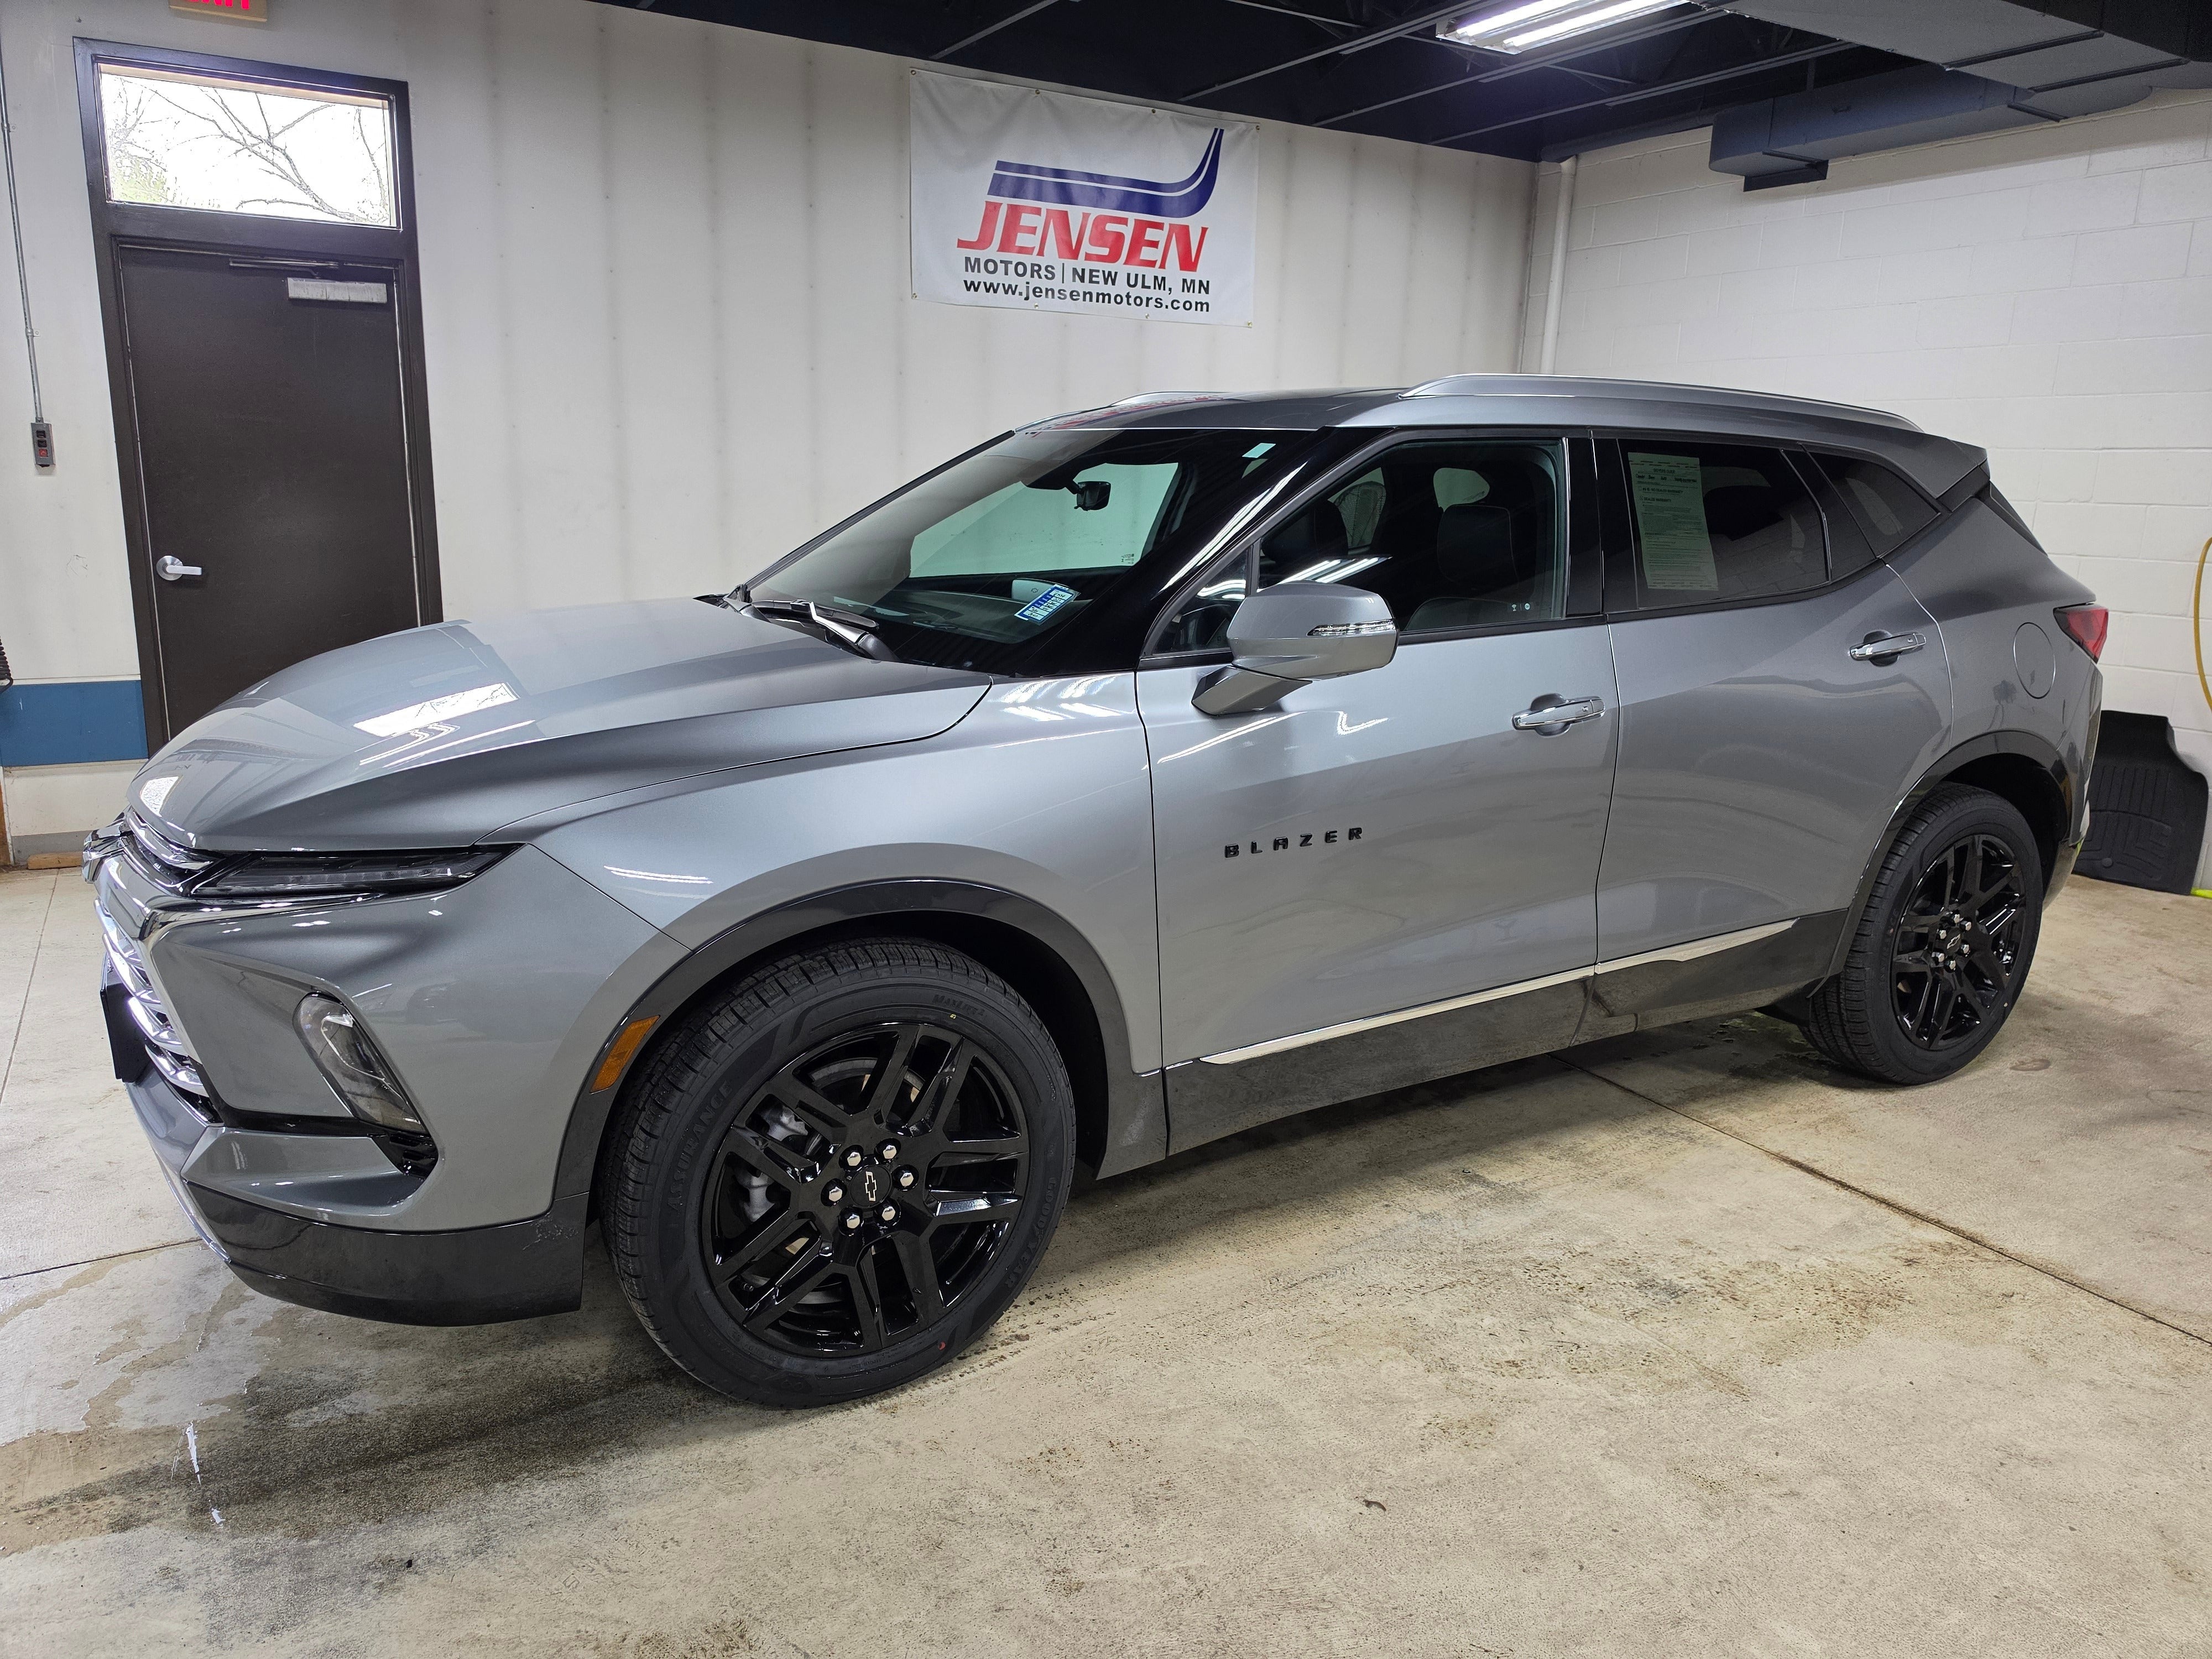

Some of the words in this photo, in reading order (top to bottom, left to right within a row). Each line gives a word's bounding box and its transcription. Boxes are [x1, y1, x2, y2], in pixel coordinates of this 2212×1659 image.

[957, 201, 1209, 272] JENSEN
[963, 280, 1209, 312] www.jensenmotors.com
[964, 256, 1056, 280] MOTORS
[1072, 267, 1118, 286] NEW
[1126, 273, 1172, 298] ULM,
[1182, 278, 1209, 295] MN
[1224, 827, 1363, 858] BLAZER
[667, 1079, 733, 1212] ASSURANCE
[1004, 1177, 1058, 1289] GOODYEAR
